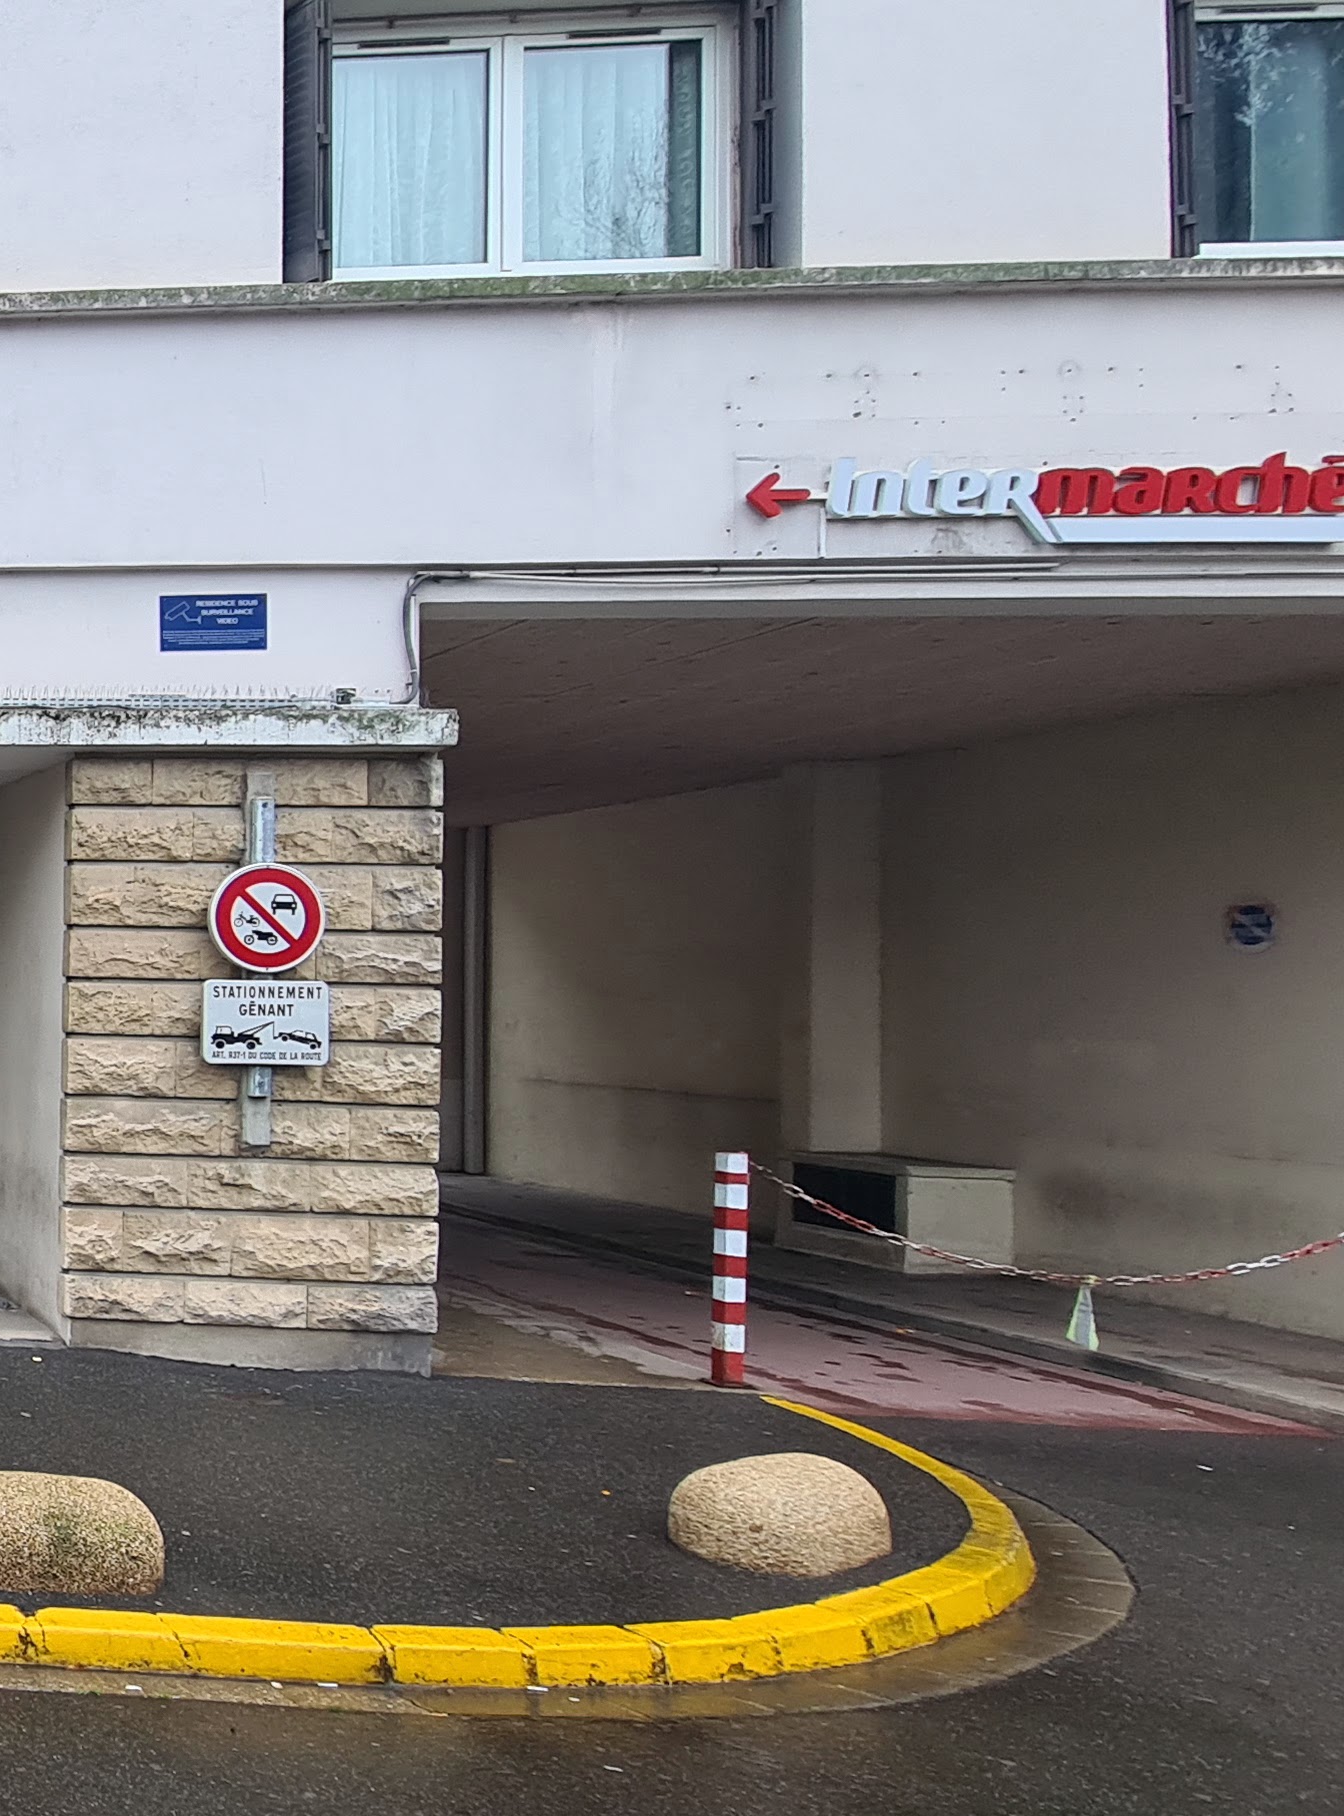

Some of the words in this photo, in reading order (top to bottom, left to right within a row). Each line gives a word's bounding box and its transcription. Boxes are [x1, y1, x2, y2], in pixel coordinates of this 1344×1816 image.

[212, 985, 323, 1000] STATIONNEMENT
[238, 1001, 294, 1017] GÊNANT
[248, 1051, 257, 1060] DU
[259, 1051, 276, 1060] CODE
[278, 1052, 287, 1060] DE
[289, 1052, 298, 1060] LA
[300, 1052, 322, 1061] ROUTE
